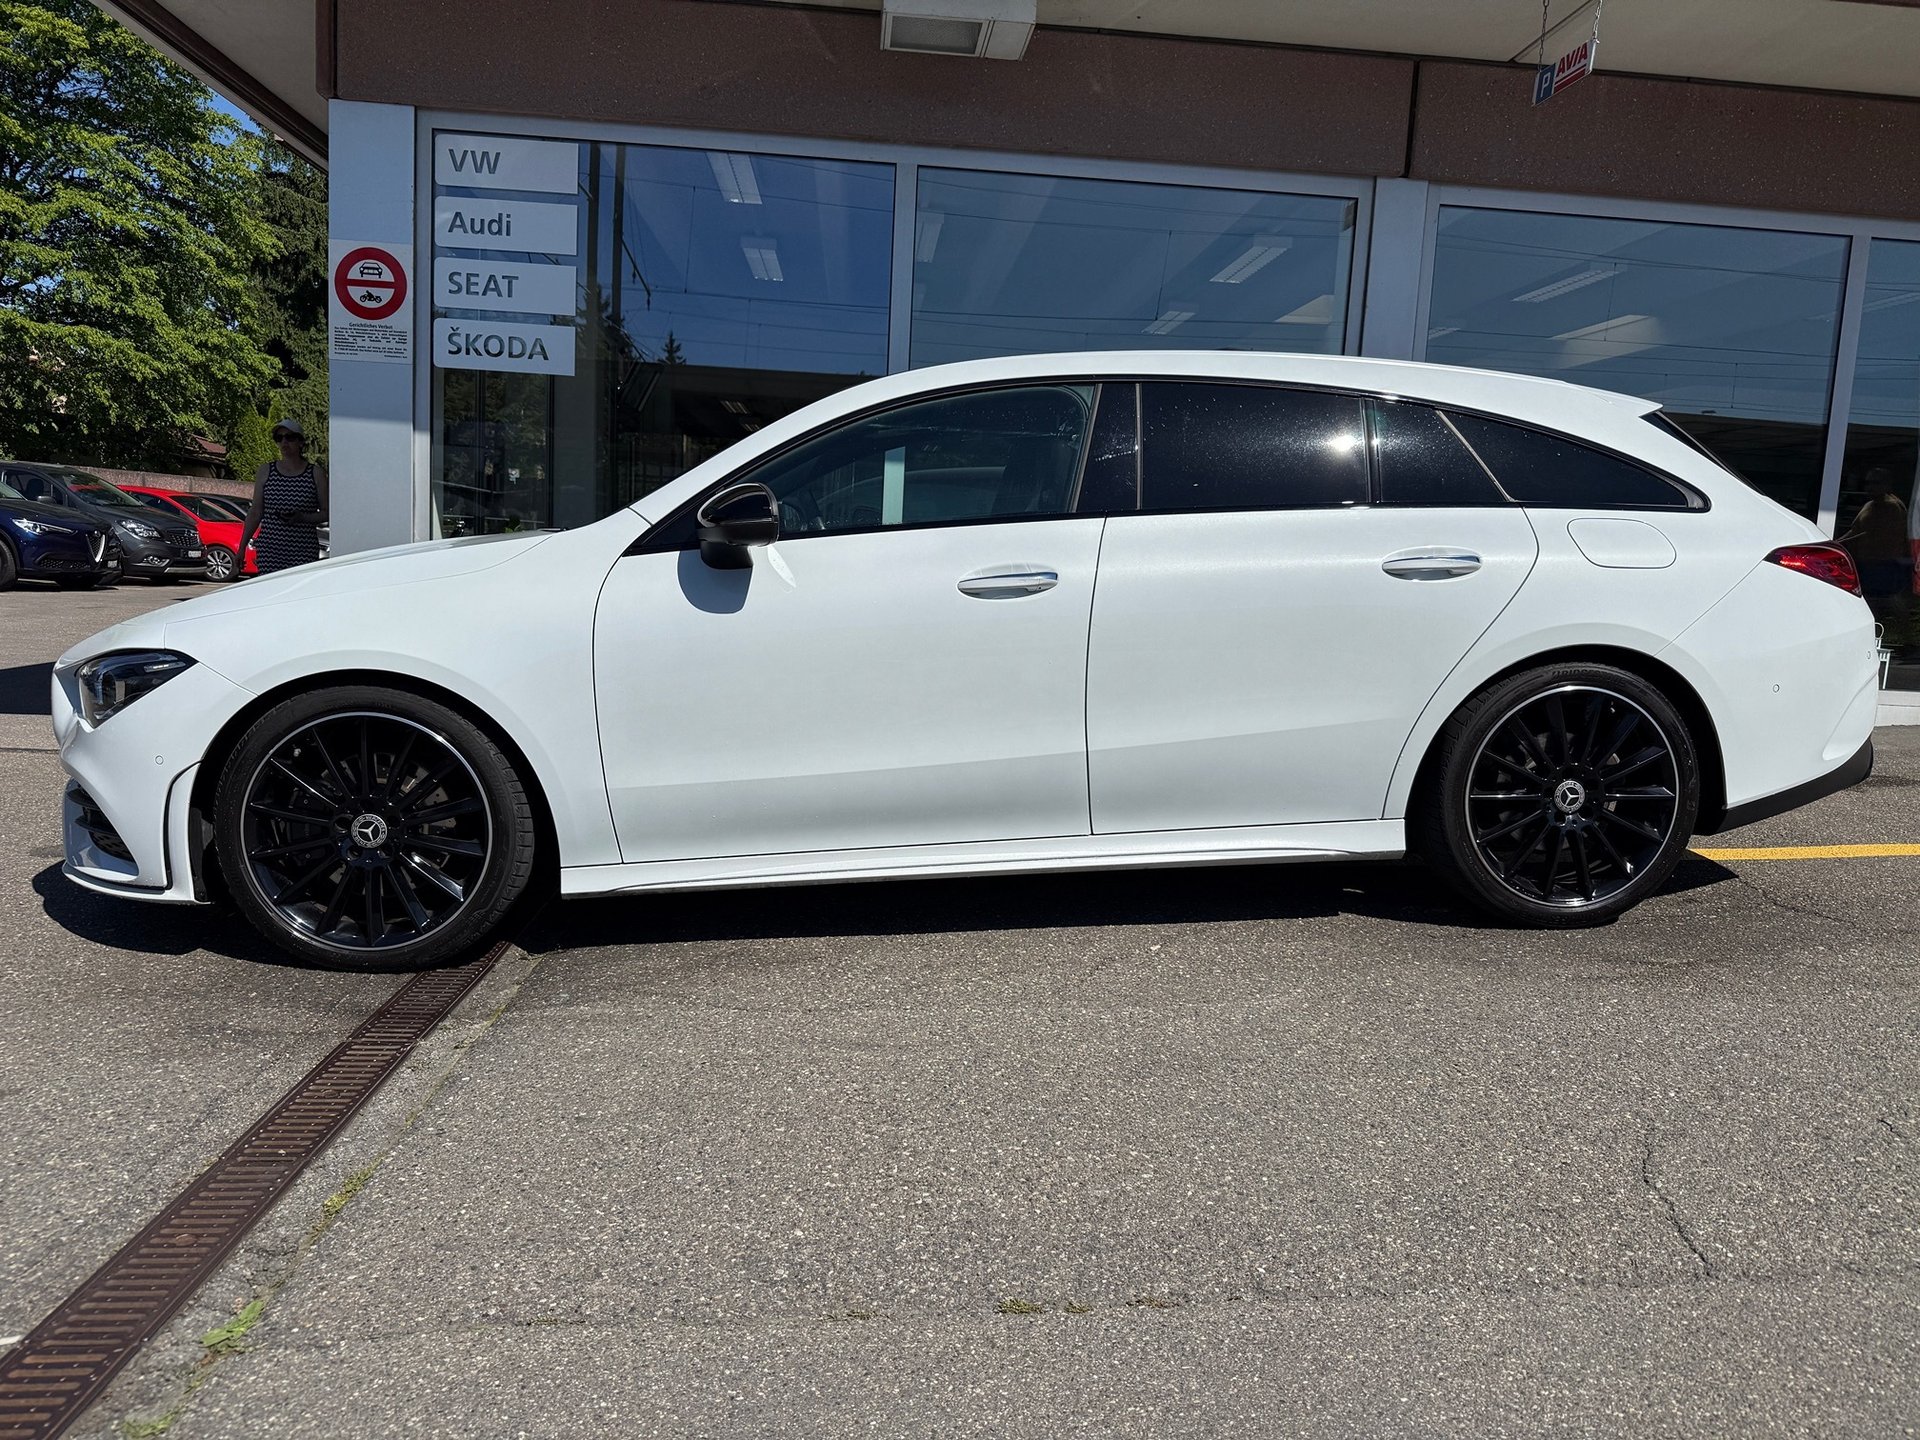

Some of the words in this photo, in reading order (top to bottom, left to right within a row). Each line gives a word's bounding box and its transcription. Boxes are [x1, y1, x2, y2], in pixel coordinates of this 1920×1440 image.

[1540, 72, 1551, 98] P
[1556, 42, 1588, 78] AVIA
[448, 148, 501, 174] VW
[447, 211, 512, 237] Audi
[448, 271, 519, 298] SEAT
[447, 326, 549, 361] ŠKODA
